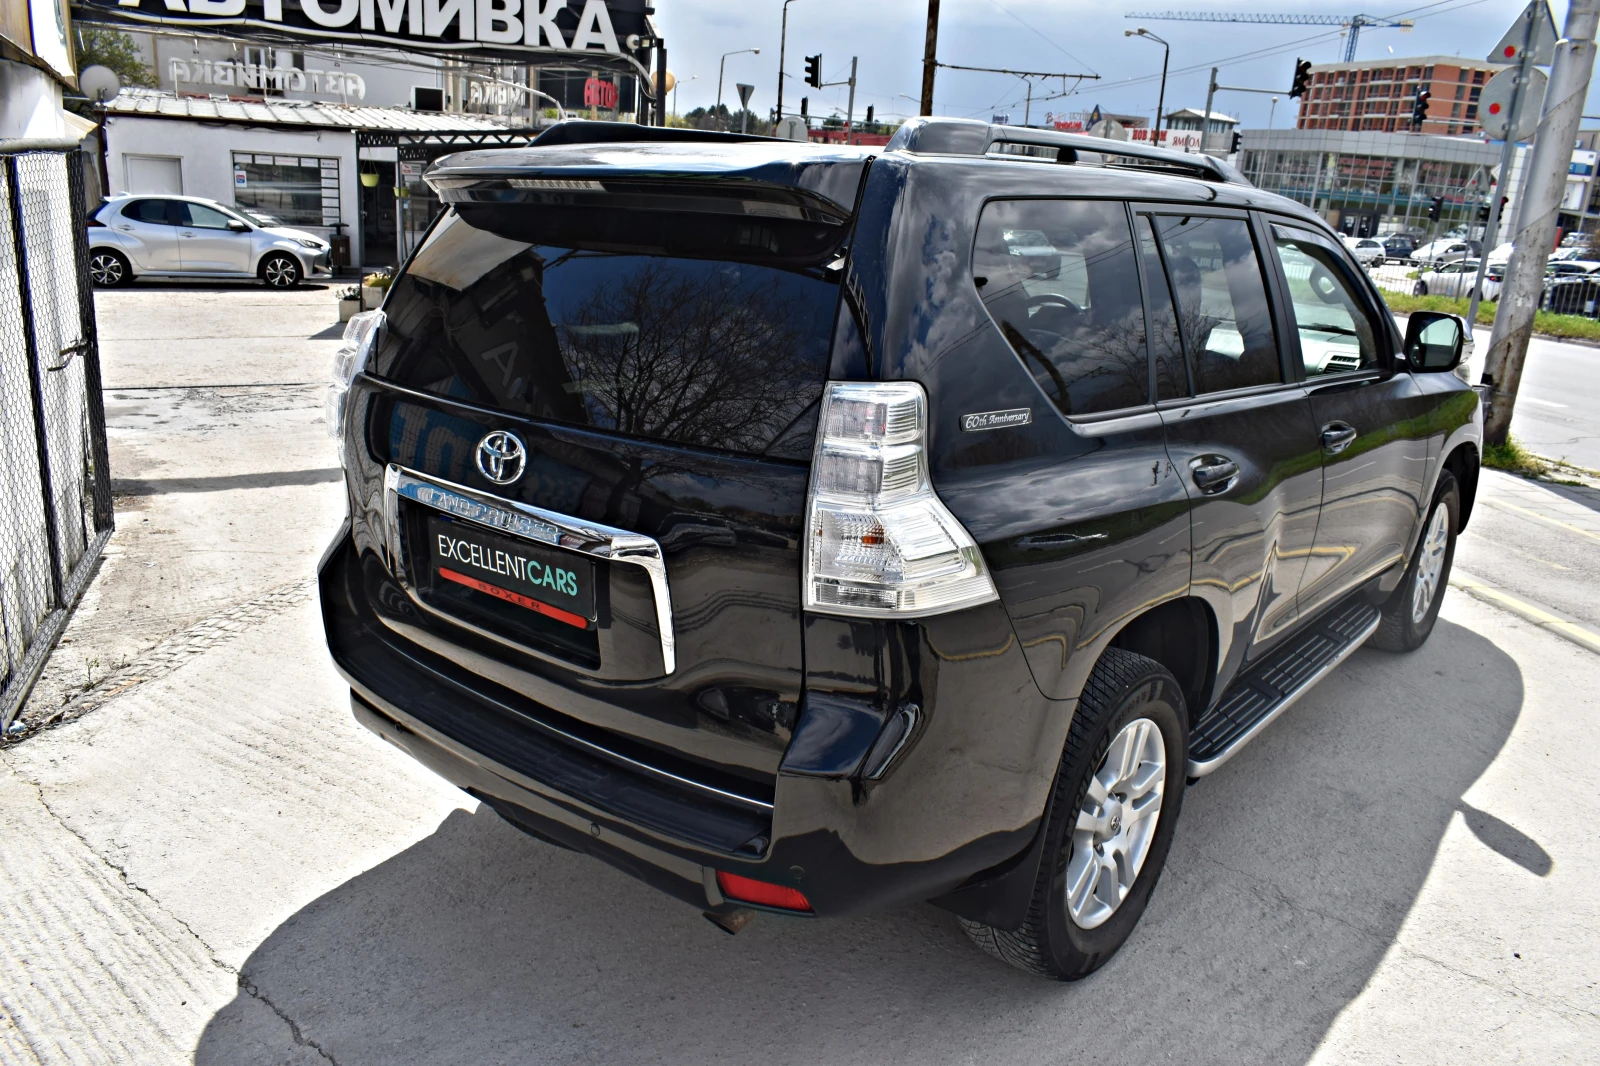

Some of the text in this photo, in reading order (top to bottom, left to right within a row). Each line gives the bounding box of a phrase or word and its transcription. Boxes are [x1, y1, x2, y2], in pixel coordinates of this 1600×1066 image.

[118, 0, 620, 53] ОМИВКА
[1149, 129, 1168, 142] ДМ
[1172, 136, 1200, 148] ЯМОЛ
[965, 412, 1030, 429] 60th Anniversary
[428, 487, 559, 543] LAND CRUISER
[477, 582, 541, 613] BOXER
[1065, 732, 1108, 836] MICHELIN
